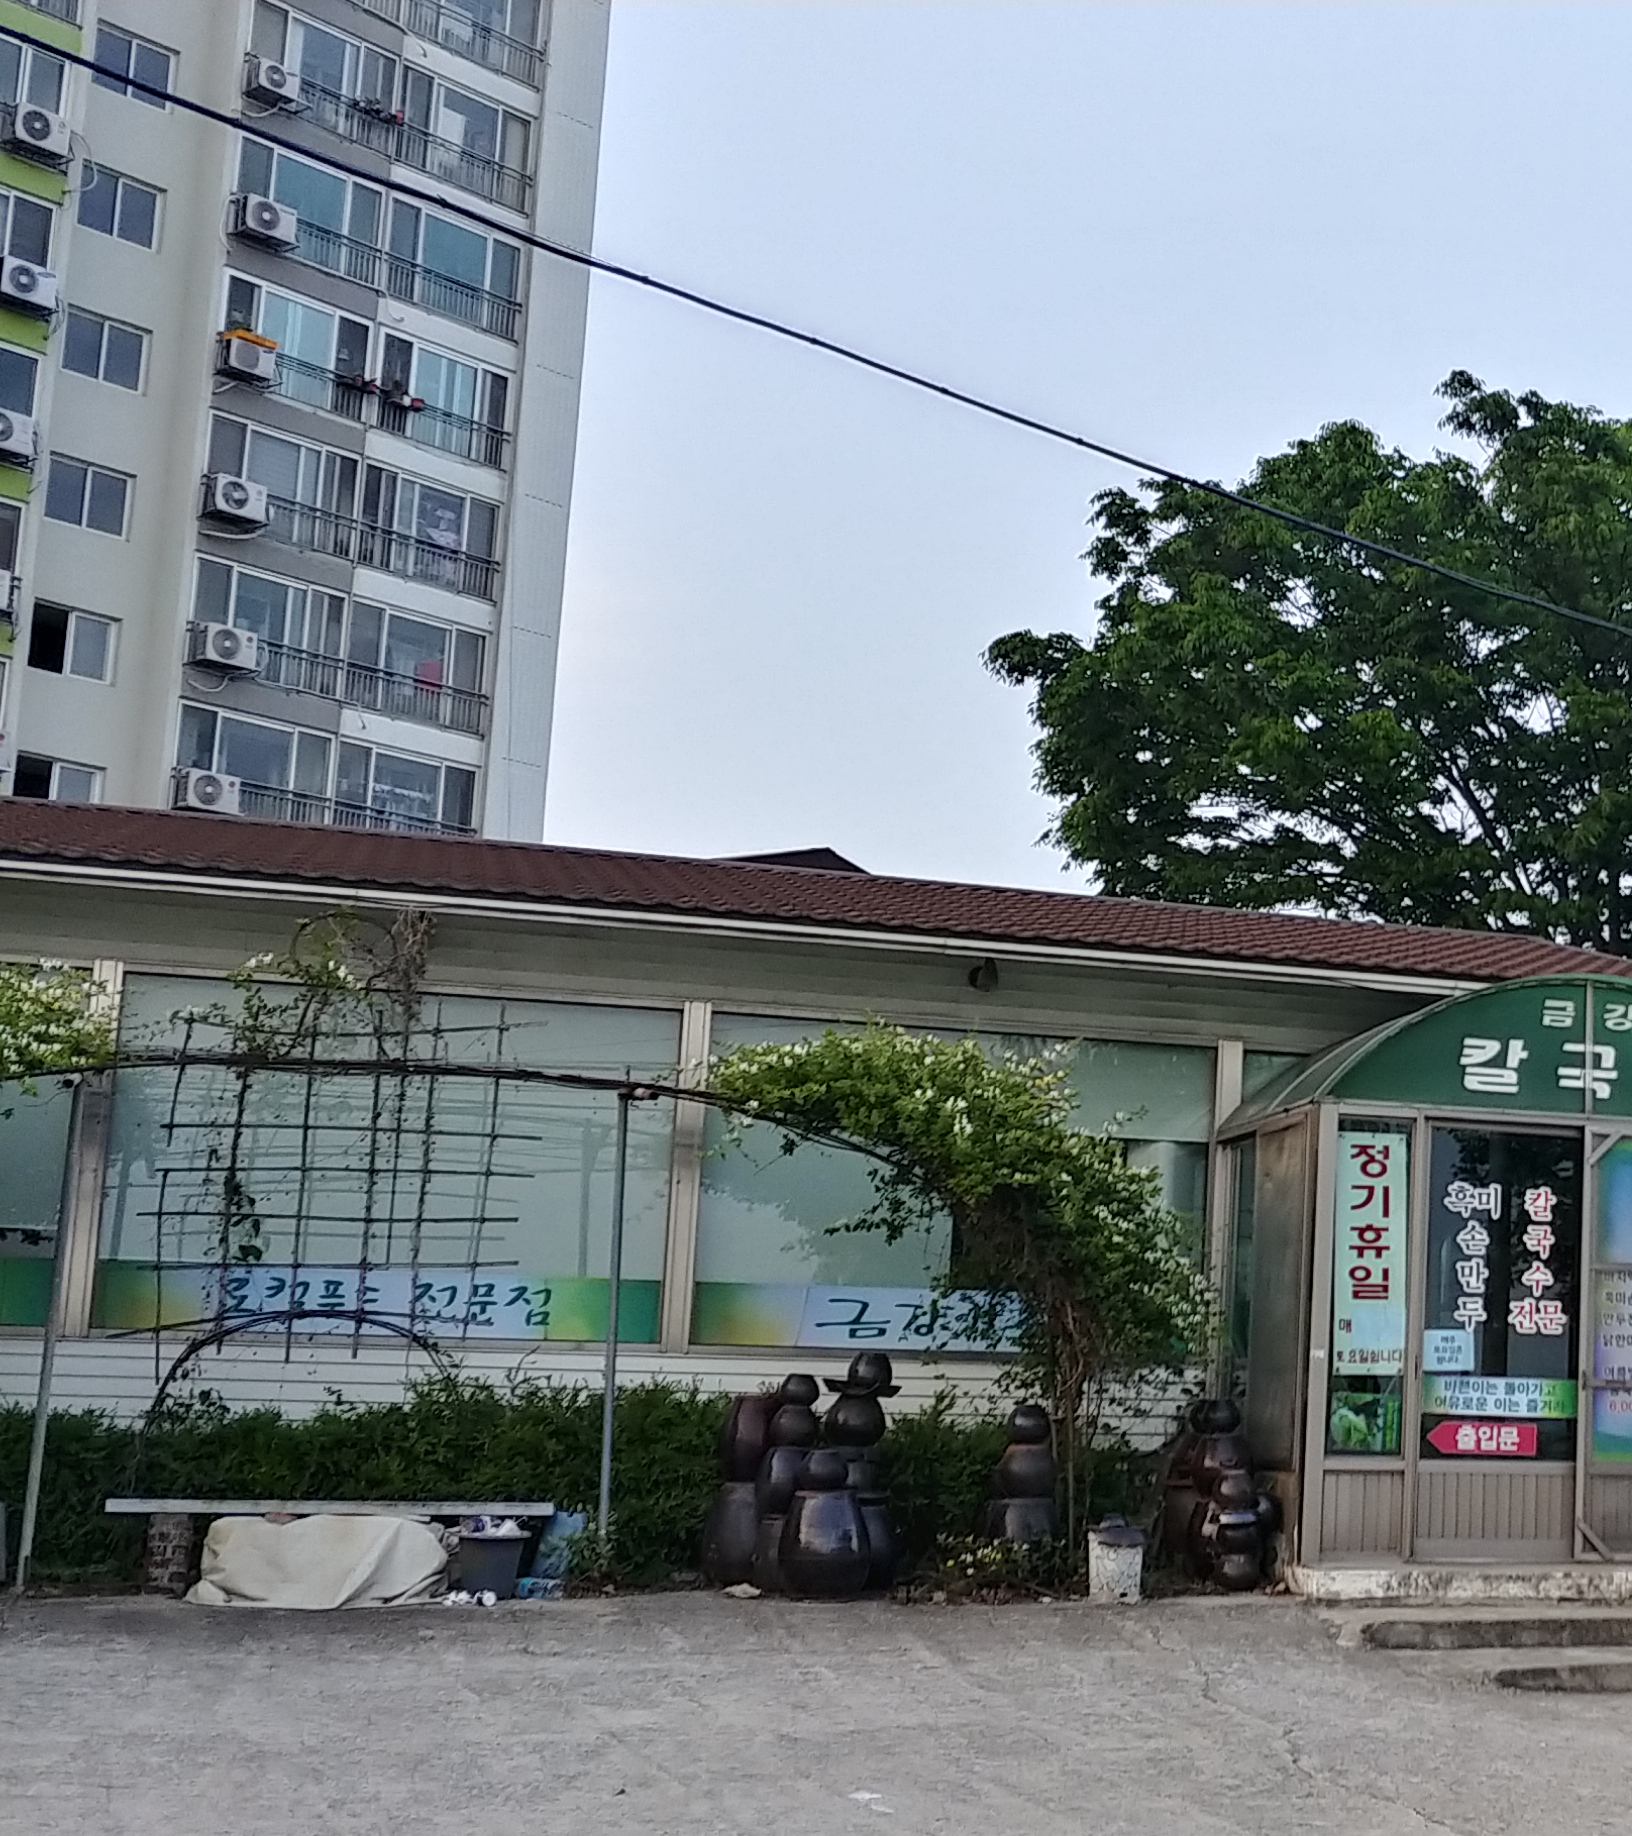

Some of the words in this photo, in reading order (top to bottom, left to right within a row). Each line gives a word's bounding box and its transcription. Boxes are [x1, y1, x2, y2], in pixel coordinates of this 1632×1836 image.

[1349, 1144, 1390, 1300] 정기휴일
[1443, 1180, 1501, 1220] 흑미
[1522, 1186, 1557, 1297] 칼국수
[1453, 1220, 1490, 1332] 손만두
[411, 1282, 553, 1327] 전문점
[1507, 1297, 1568, 1335] 전문
[1455, 1424, 1520, 1451] 출입문
